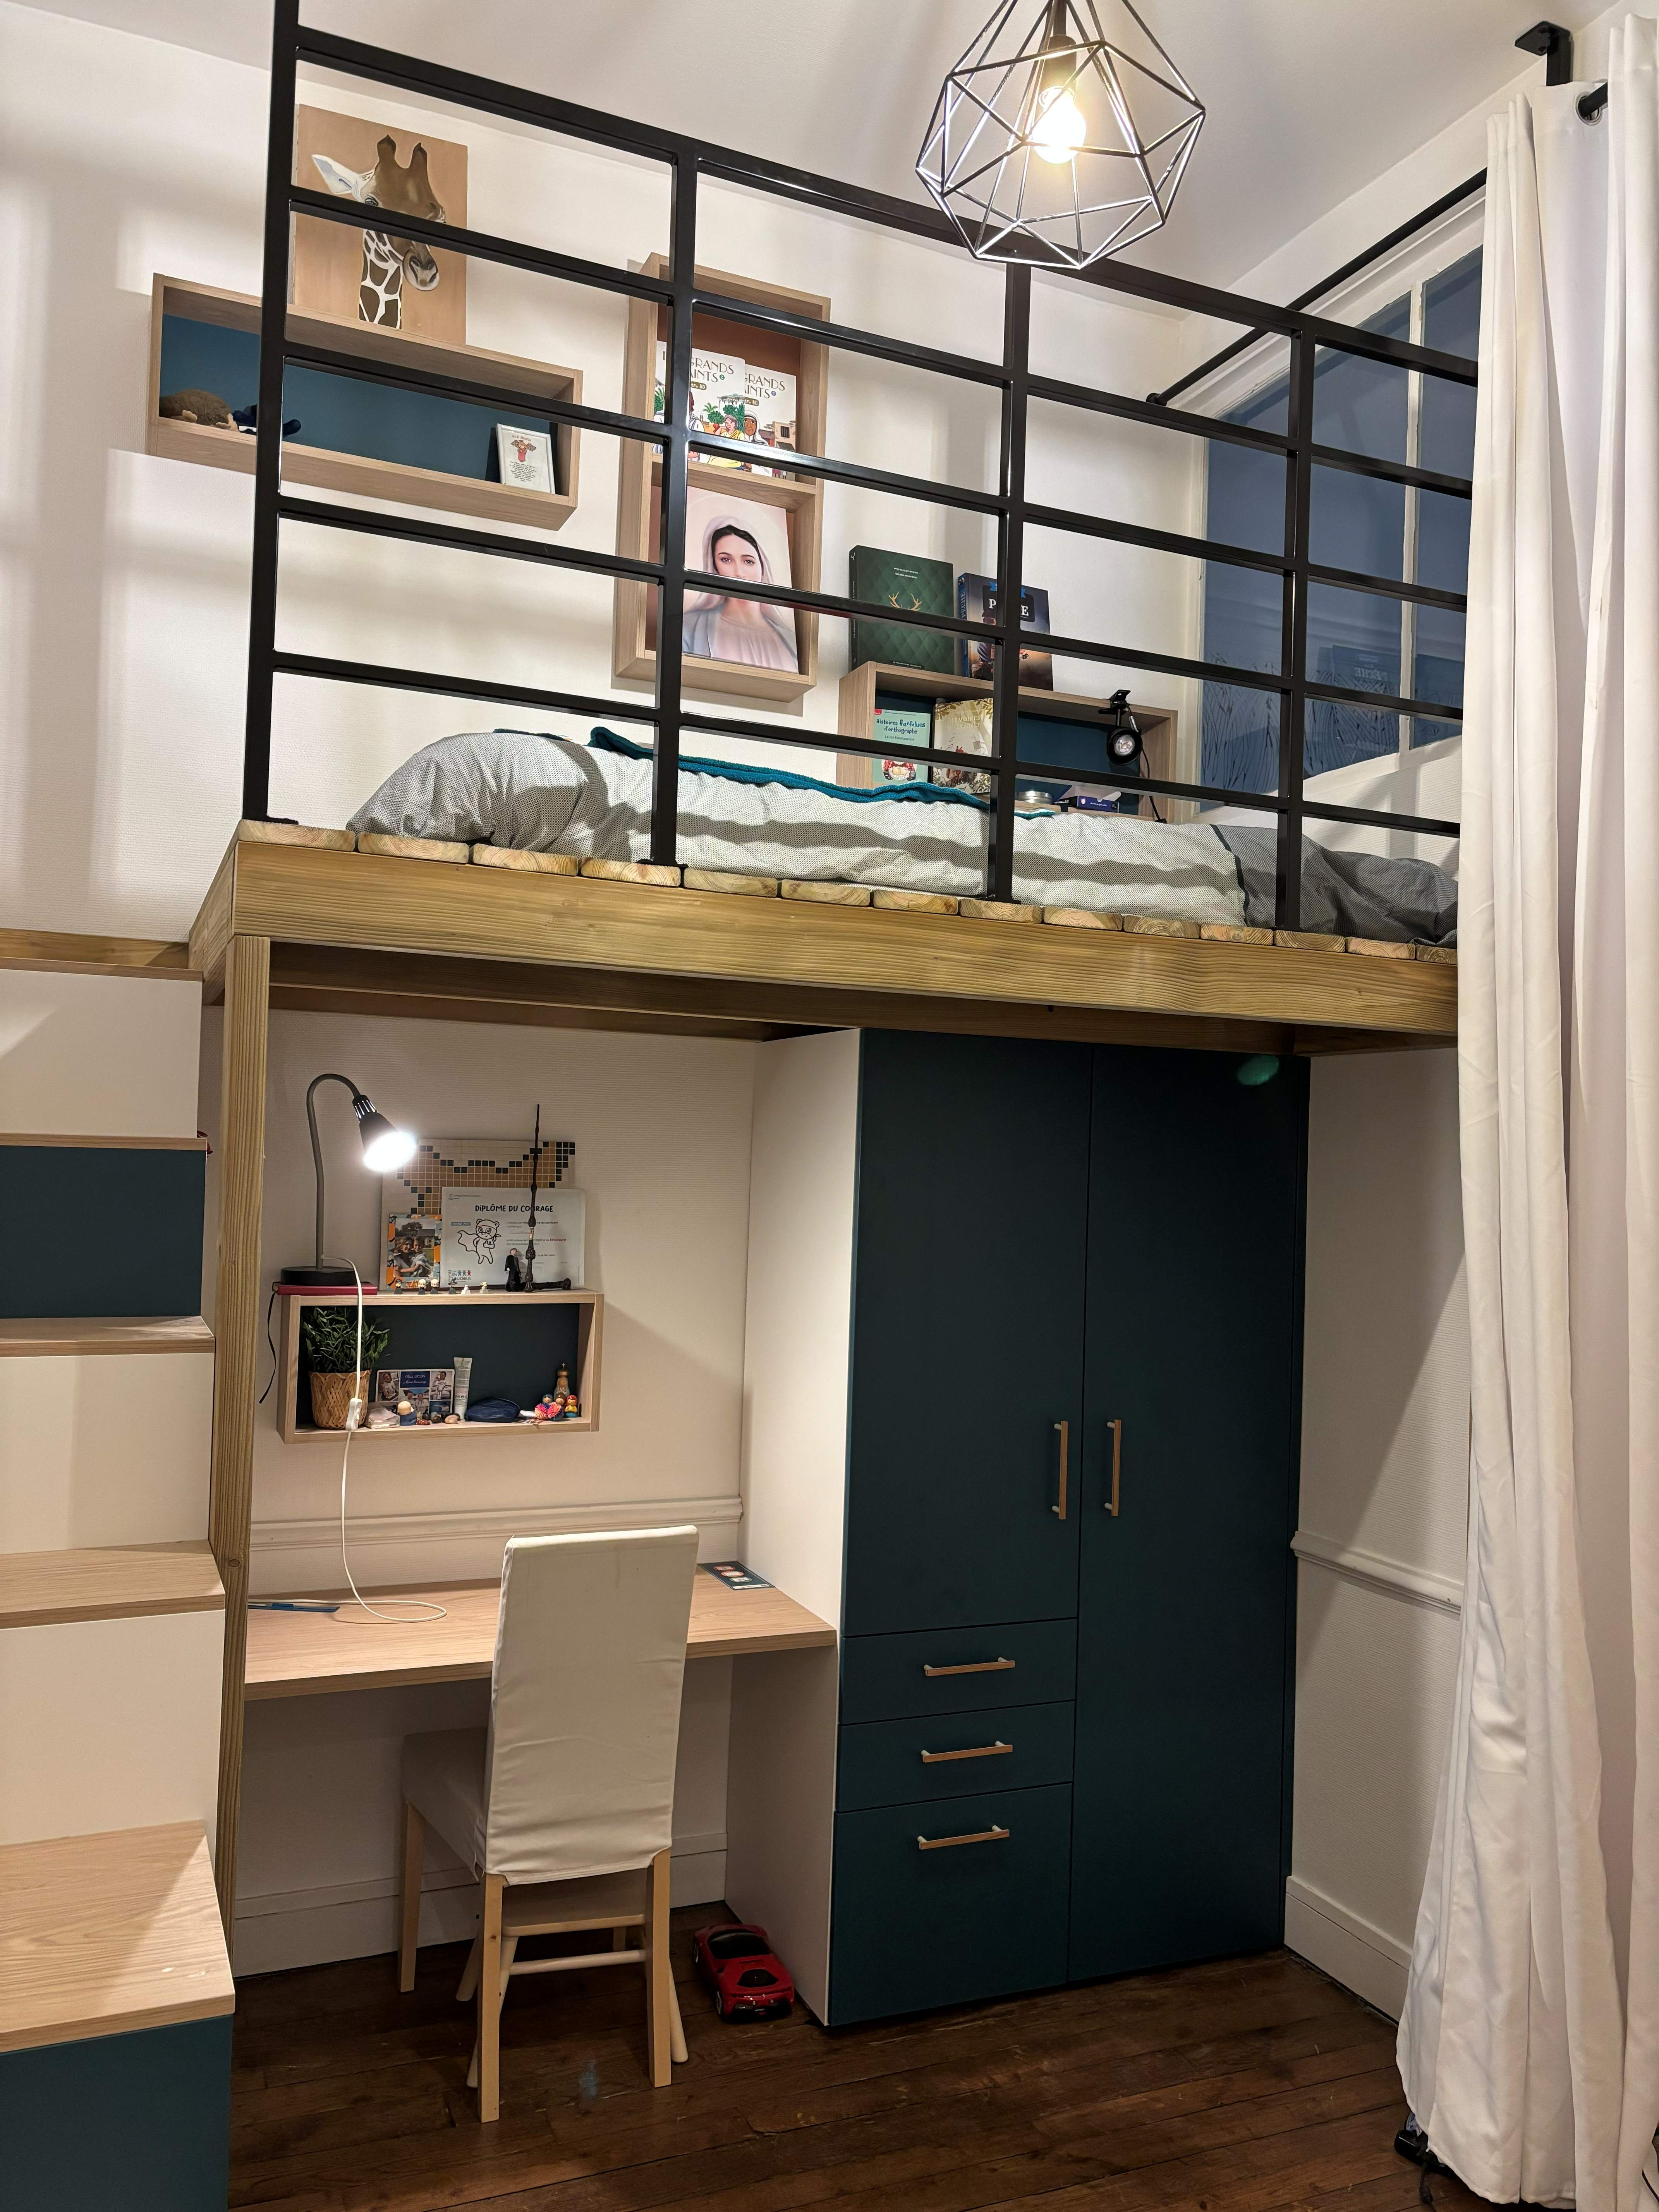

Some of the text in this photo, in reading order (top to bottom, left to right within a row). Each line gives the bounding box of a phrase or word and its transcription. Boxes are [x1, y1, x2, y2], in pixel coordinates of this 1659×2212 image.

[691, 369, 718, 383] INTS
[745, 385, 770, 398] INTS
[899, 719, 926, 727] farfelues
[884, 726, 917, 734] d'orthographe
